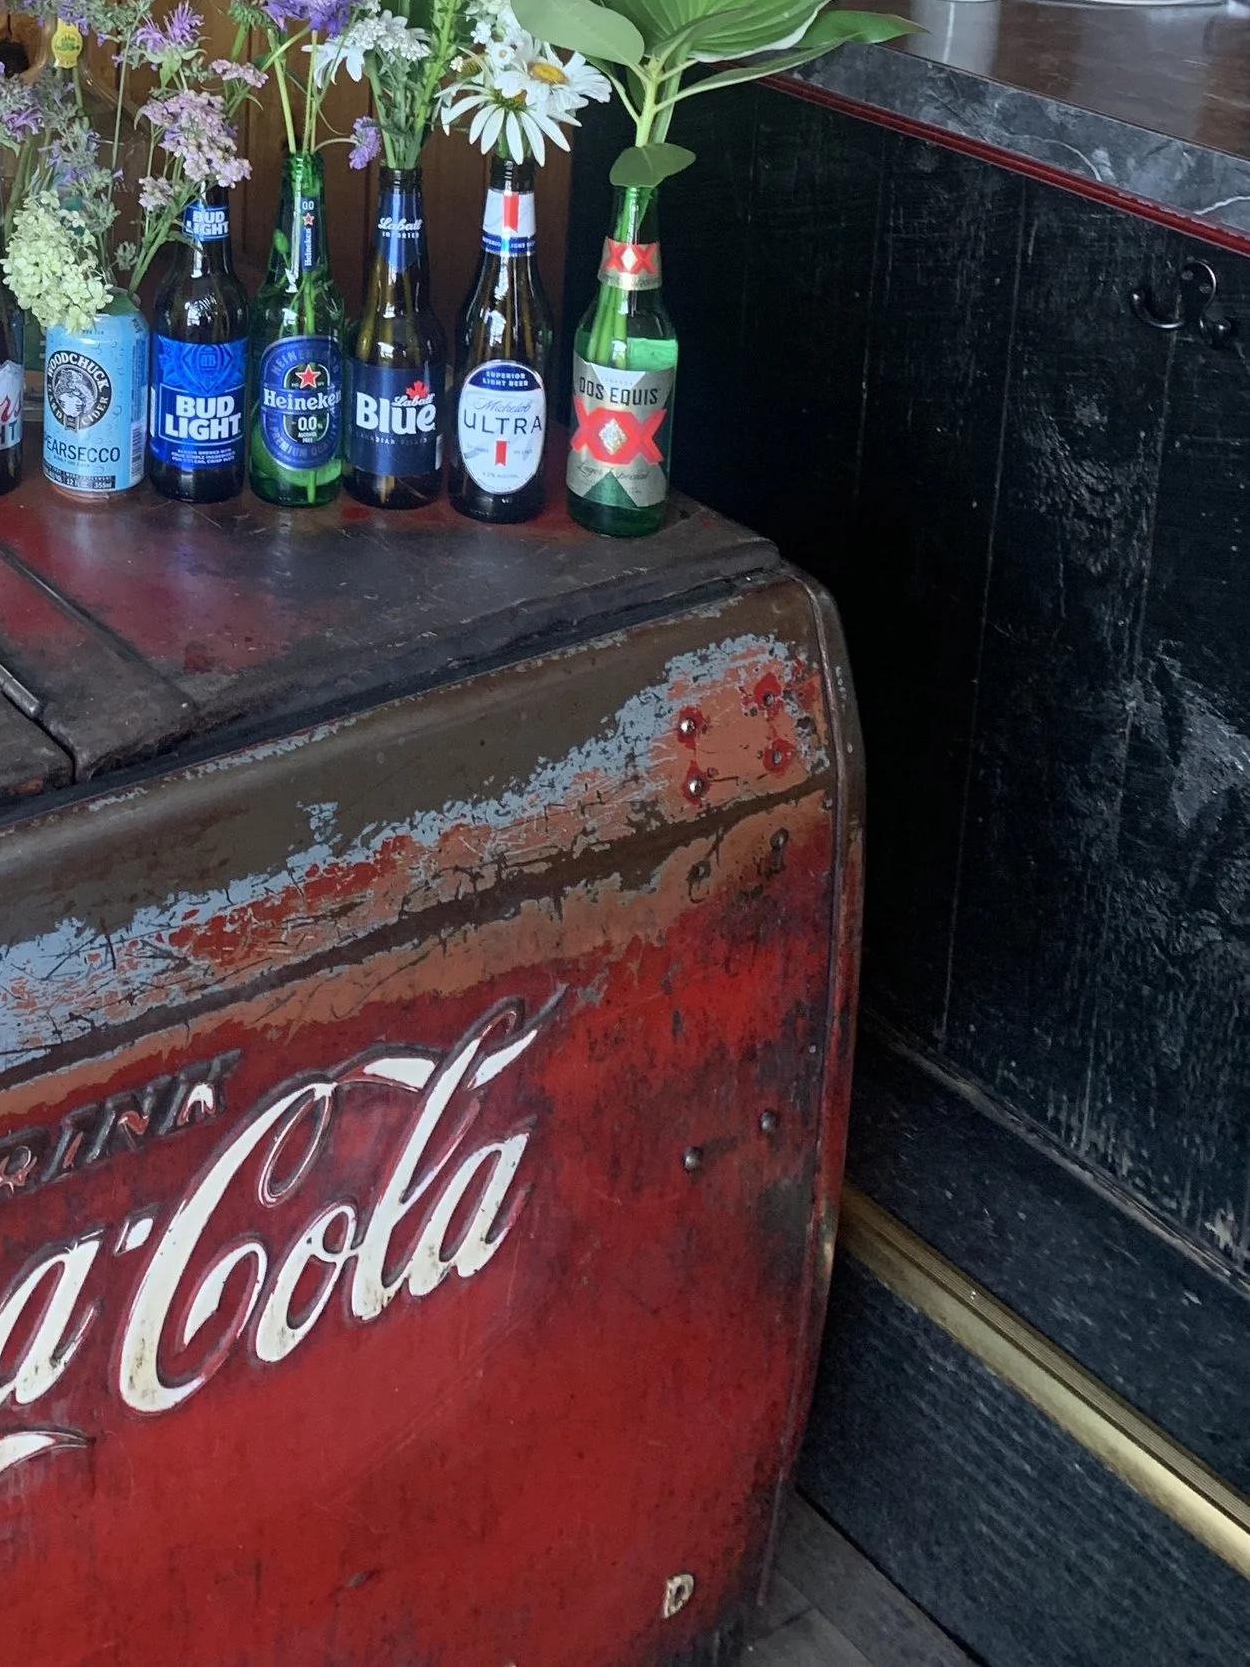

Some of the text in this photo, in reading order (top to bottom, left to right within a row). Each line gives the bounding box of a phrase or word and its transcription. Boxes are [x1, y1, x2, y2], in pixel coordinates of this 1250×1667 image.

[185, 220, 229, 235] LIGHT
[192, 210, 225, 223] BUD
[378, 218, 423, 231] Labatt
[264, 387, 341, 411] Heineken
[391, 393, 435, 407] Labatt
[579, 377, 659, 406] DOS EQUIS
[176, 395, 235, 419] BUD
[356, 392, 436, 435] Blue
[165, 412, 241, 441] LIGHT
[463, 409, 543, 435] ULTRA
